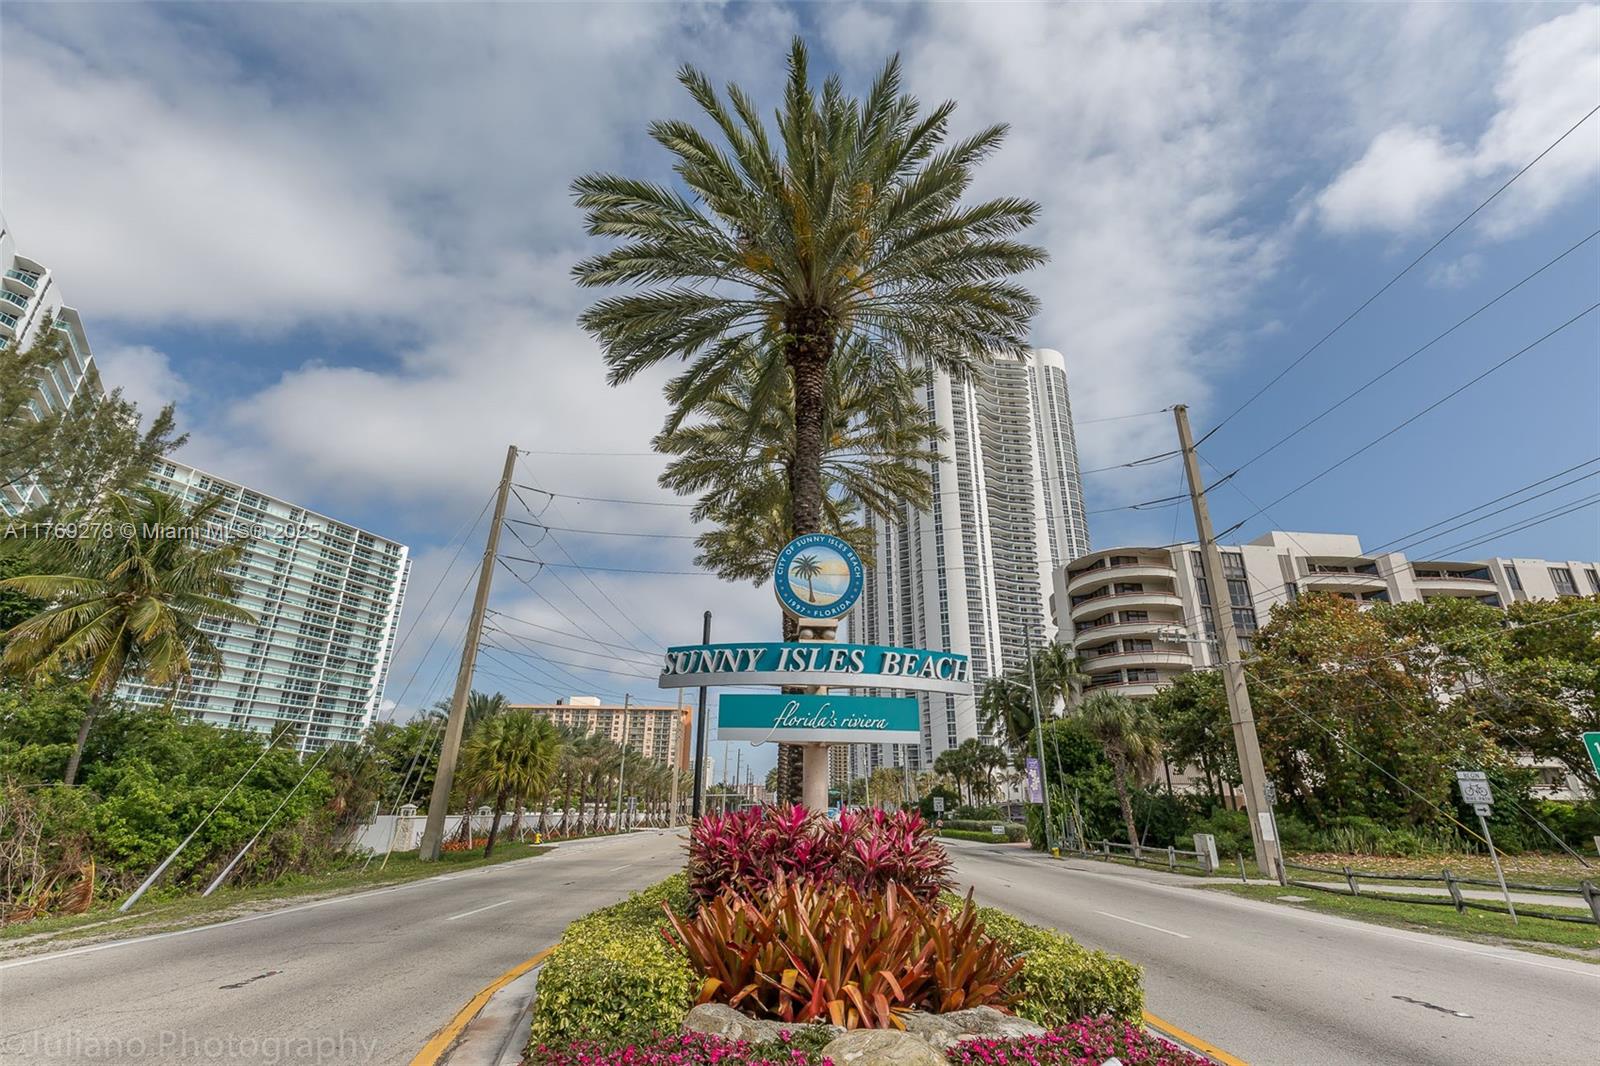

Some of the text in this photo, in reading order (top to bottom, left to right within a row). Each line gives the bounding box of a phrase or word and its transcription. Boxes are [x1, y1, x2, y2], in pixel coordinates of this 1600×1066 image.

[777, 536, 861, 578] CITY OF SUNNY ISLES BEACH
[814, 600, 851, 617] FLORIDA
[662, 647, 973, 682] SUNNY ISLES BEACH
[751, 700, 889, 746] florida's riviera
